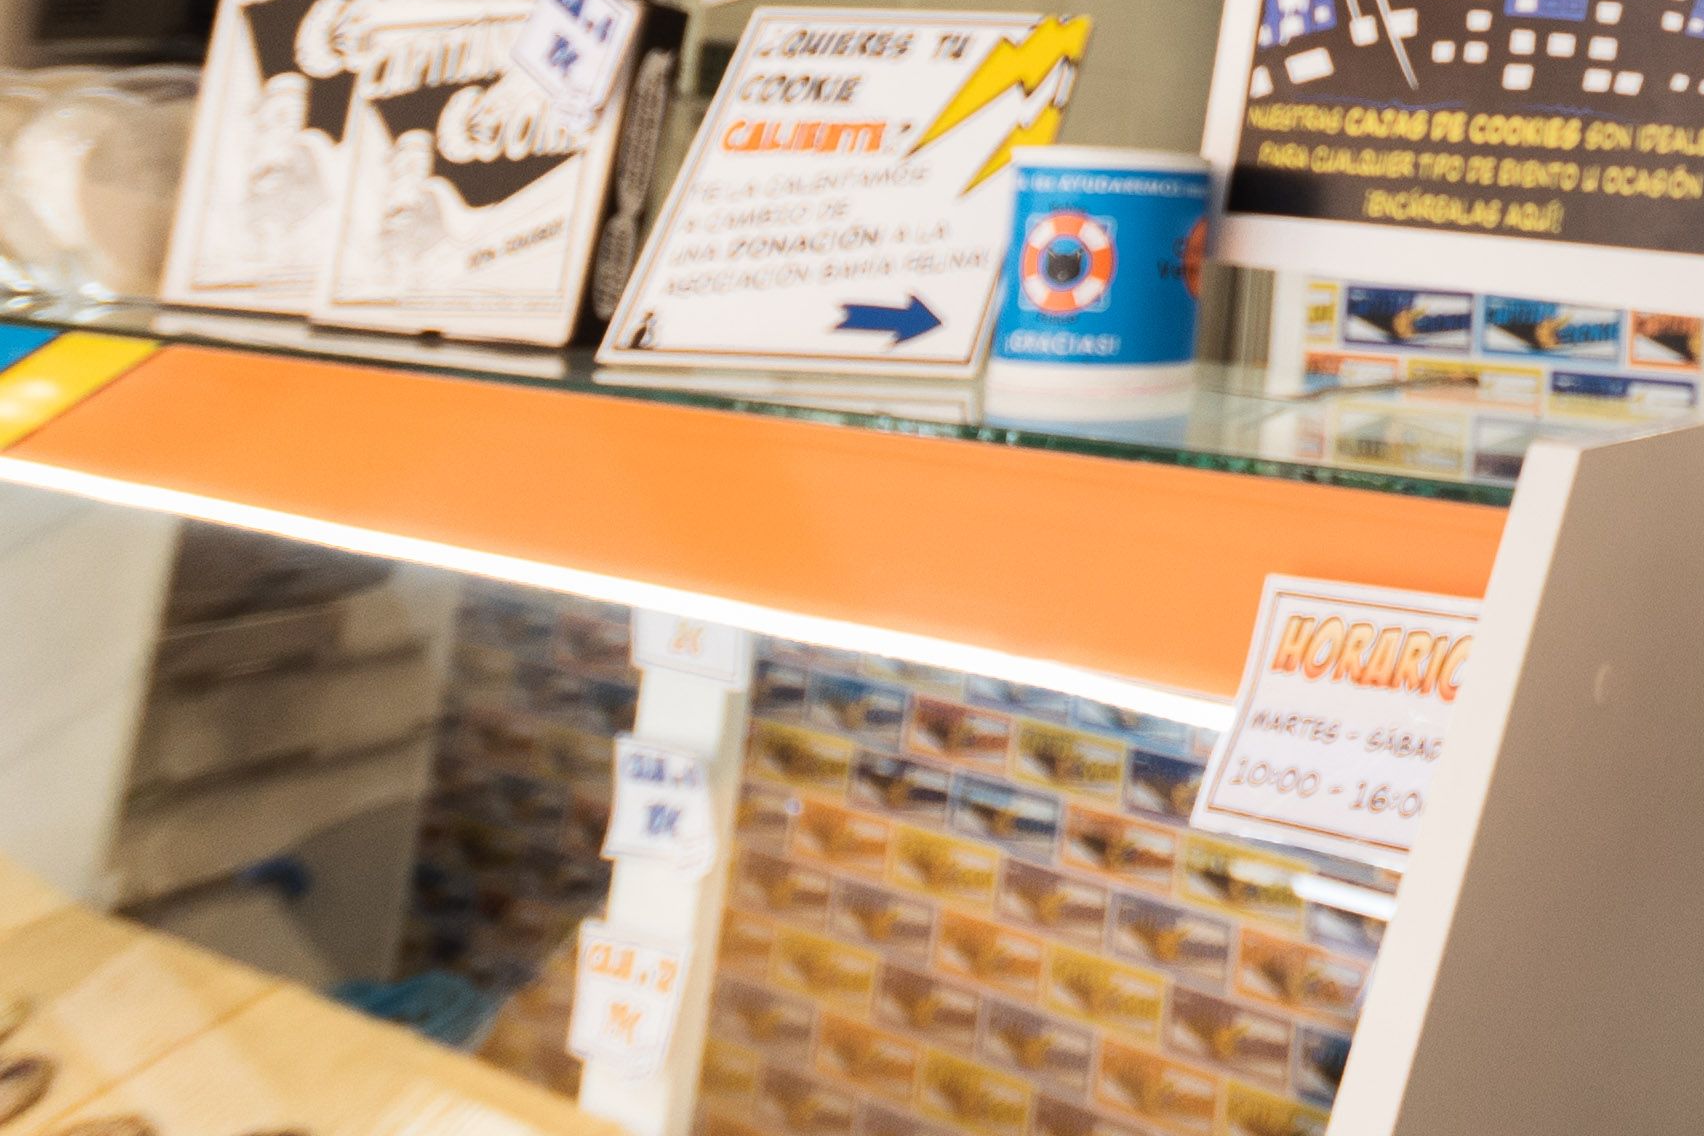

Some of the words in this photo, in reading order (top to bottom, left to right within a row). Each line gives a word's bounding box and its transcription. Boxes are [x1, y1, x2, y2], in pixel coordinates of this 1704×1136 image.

[931, 32, 972, 60] TU
[739, 74, 863, 104] COOKIE
[1430, 110, 1467, 144] DE
[1469, 112, 1583, 152] COOKIES
[1584, 120, 1634, 152] SON
[1252, 711, 1341, 745] MARTES
[1366, 723, 1444, 763] SÁBAD
[1228, 757, 1321, 799] 10:00
[1349, 781, 1424, 818] 16:0
